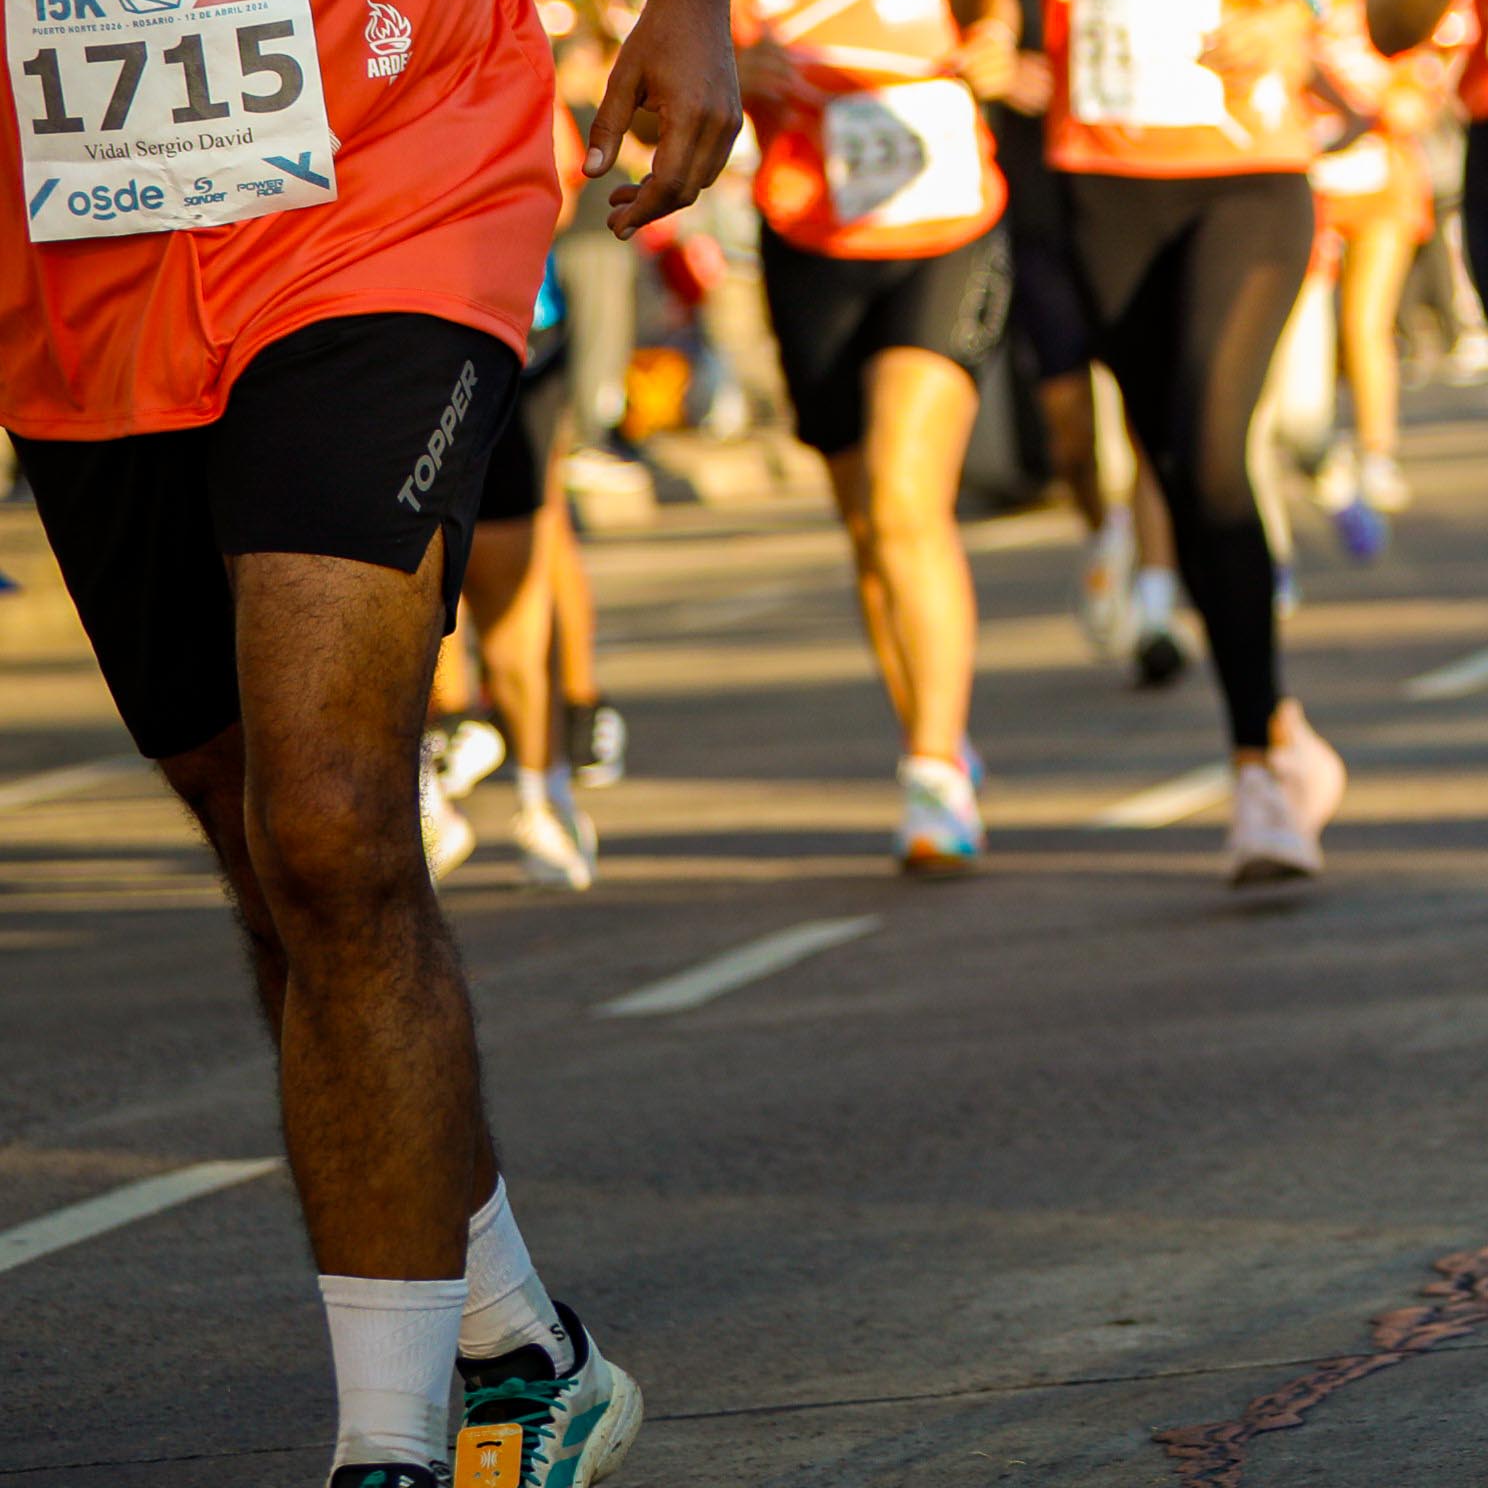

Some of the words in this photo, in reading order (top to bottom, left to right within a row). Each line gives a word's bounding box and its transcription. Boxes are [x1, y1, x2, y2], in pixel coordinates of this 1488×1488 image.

[32, 24, 66, 36] PUERTO
[68, 22, 98, 34] NORTE
[100, 23, 123, 32] 2026
[133, 17, 175, 29] ROSARIO
[184, 11, 196, 22] 12
[199, 10, 212, 20] DE
[215, 6, 244, 17] ABRIL
[23, 19, 304, 135] 1715
[85, 142, 131, 161] Vidal
[135, 139, 194, 159] Sergio
[198, 127, 254, 150] David
[68, 179, 164, 218] osde
[237, 178, 284, 193] POWER
[397, 359, 478, 512] TOPPER
